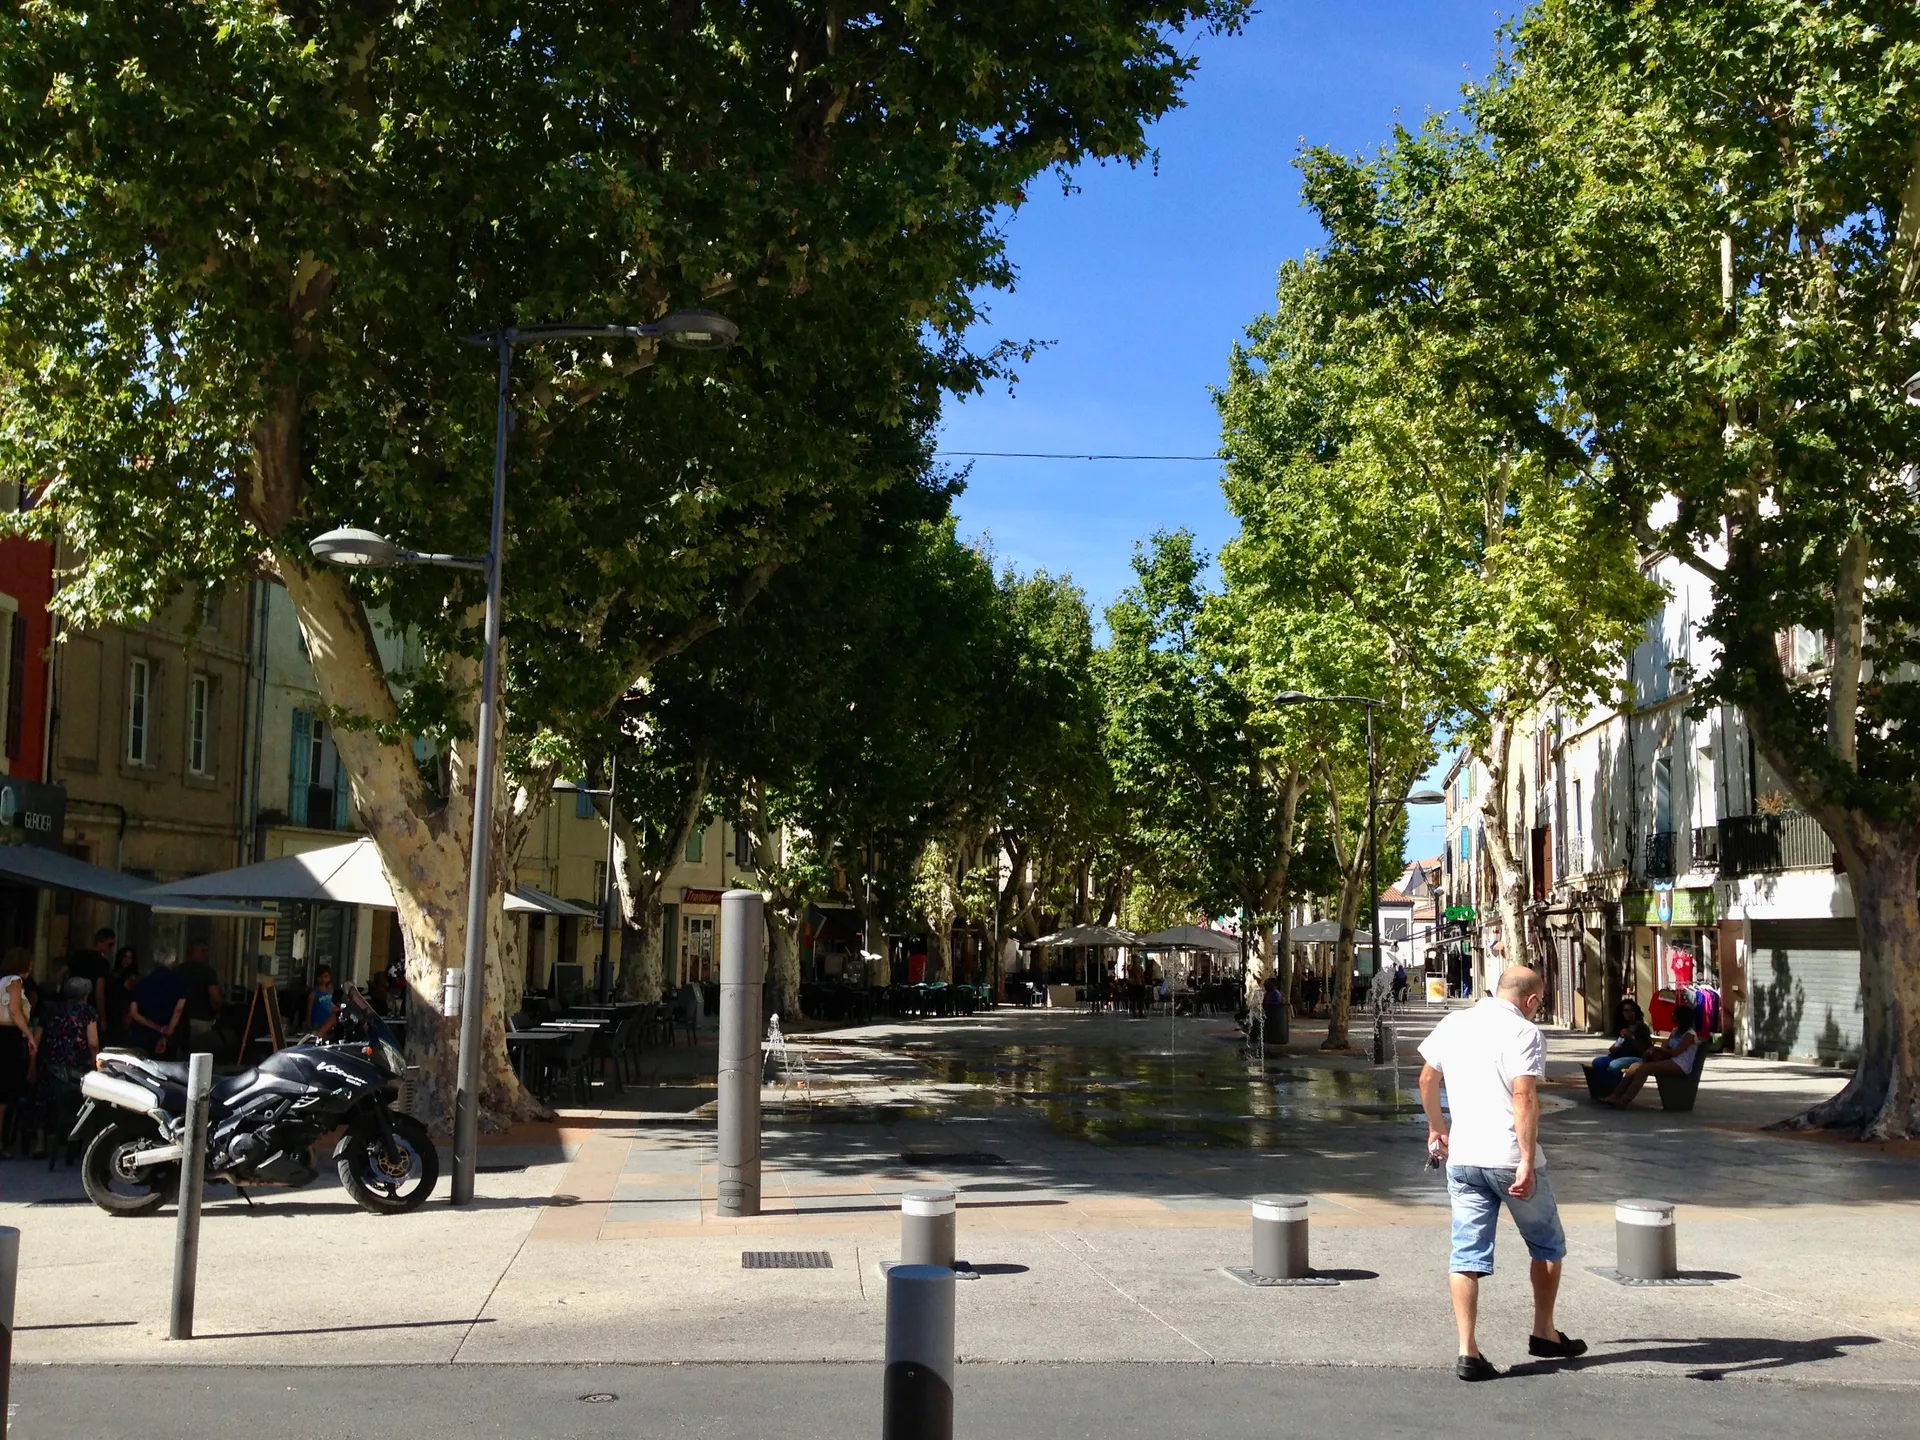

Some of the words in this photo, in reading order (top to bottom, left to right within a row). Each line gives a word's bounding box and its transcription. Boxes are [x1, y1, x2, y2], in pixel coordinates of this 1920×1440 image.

[24, 811, 52, 832] GLACIER
[686, 890, 715, 902] Traiteur
[1724, 880, 1775, 907] Paradise
